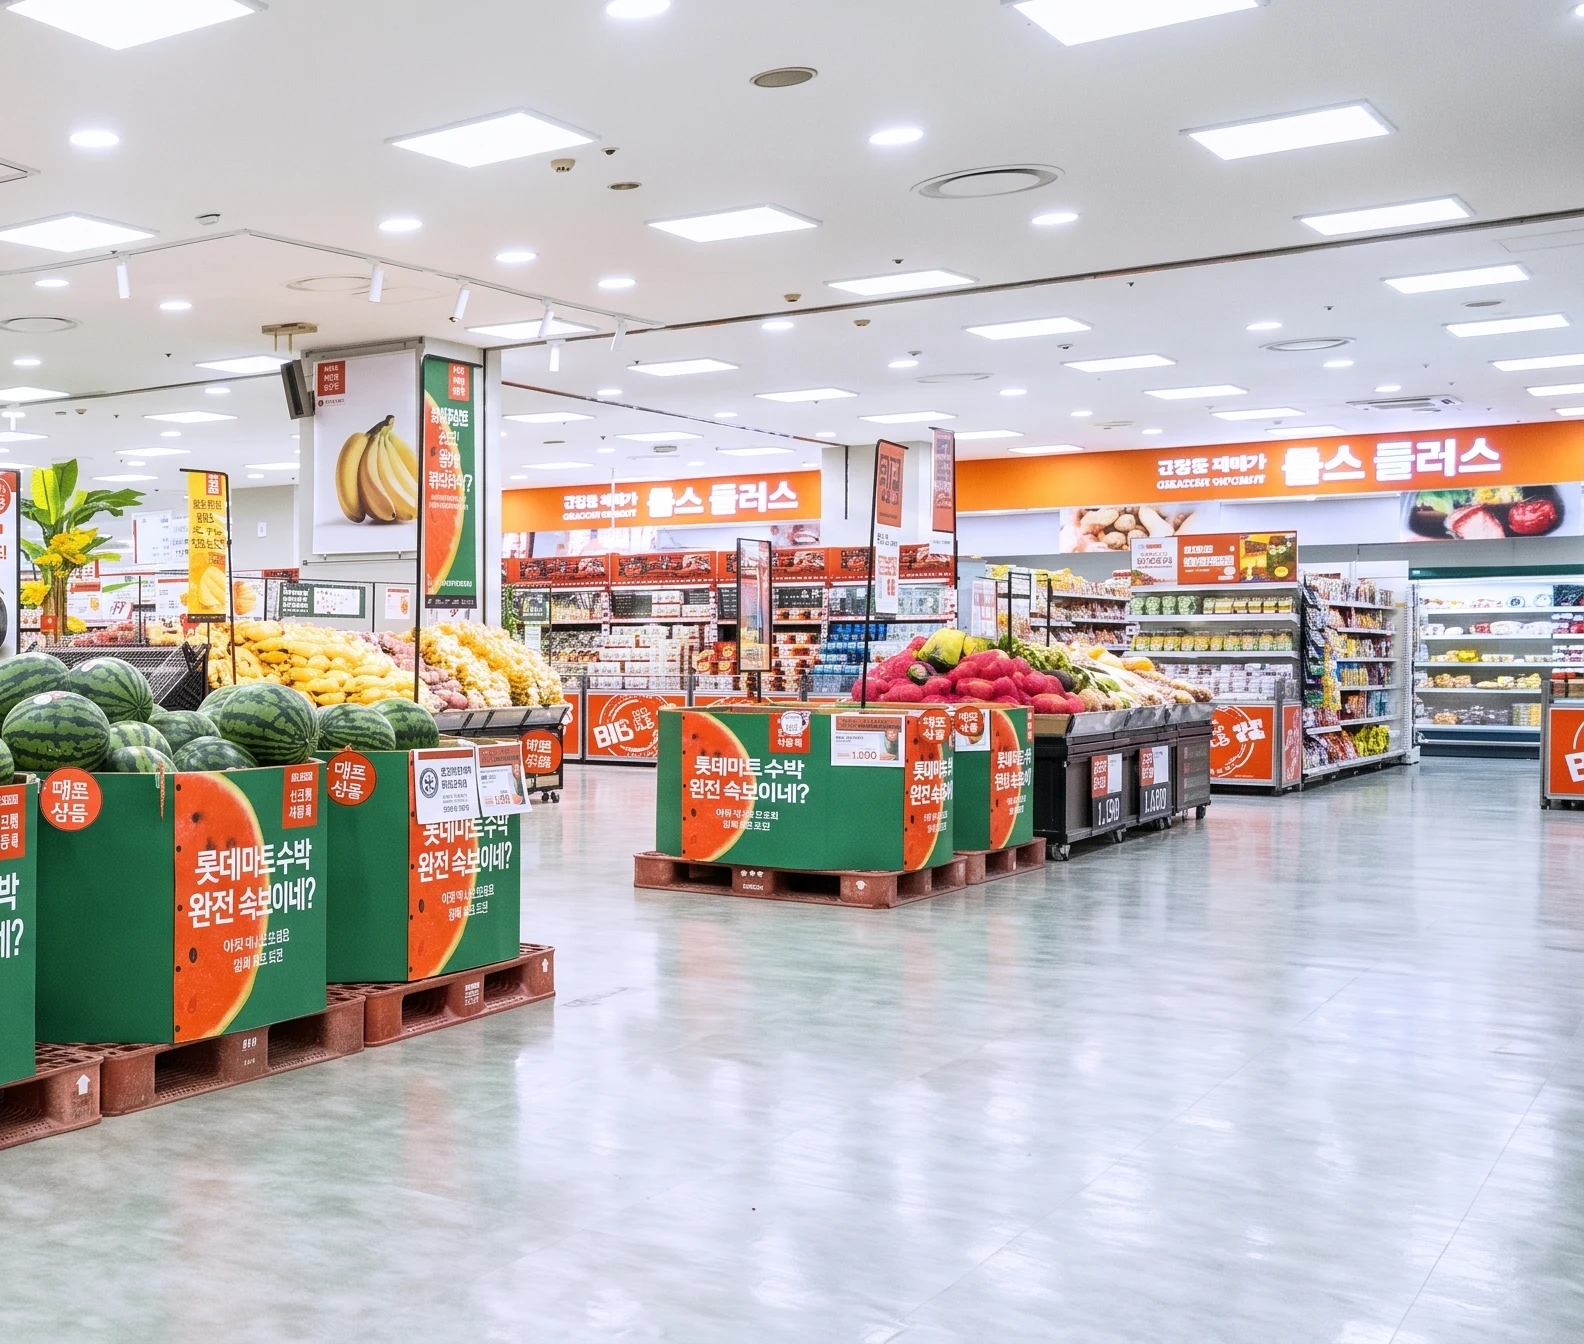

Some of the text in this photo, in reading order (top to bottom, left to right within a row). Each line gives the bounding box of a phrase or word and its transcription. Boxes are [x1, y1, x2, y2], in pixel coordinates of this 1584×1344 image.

[764, 759, 805, 780] 수박
[723, 782, 810, 804] 속보이네?
[194, 838, 312, 886] 롯데마트 수박
[417, 841, 512, 883] 완전 속보이네?
[187, 876, 316, 929] 완전 속보이네?
